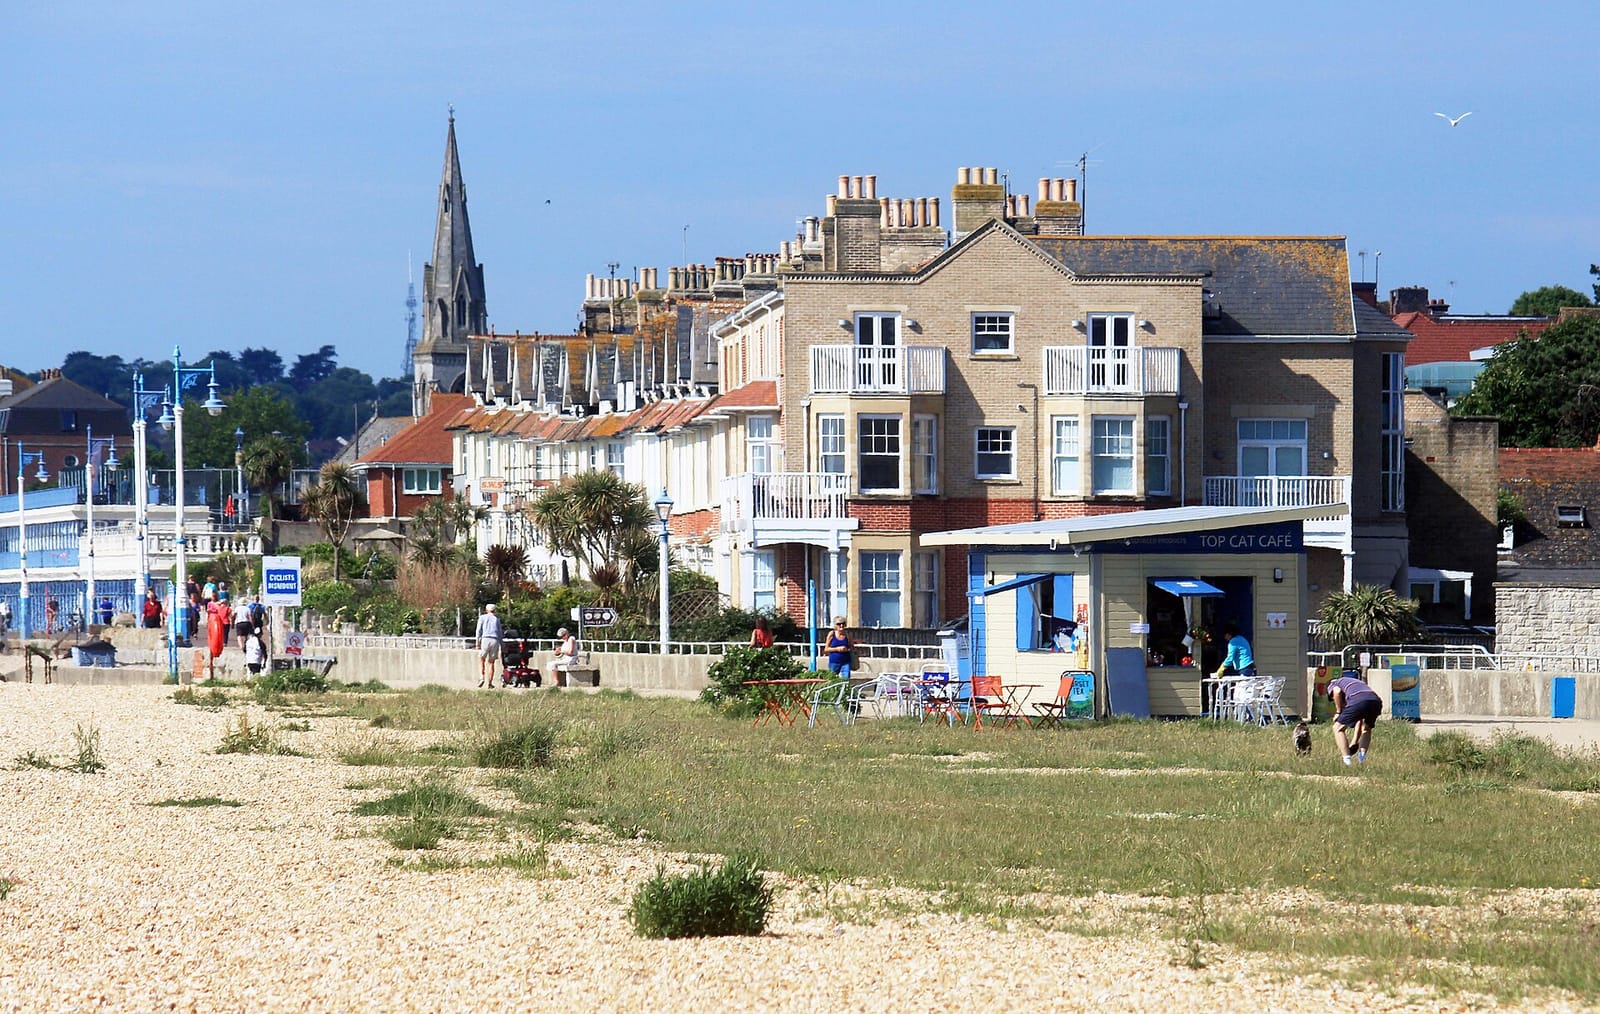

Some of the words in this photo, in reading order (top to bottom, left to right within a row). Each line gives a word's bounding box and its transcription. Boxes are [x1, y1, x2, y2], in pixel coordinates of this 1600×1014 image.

[1200, 535, 1226, 548] TOP
[1229, 535, 1256, 548] CAT
[1259, 531, 1293, 548] CAFÉ
